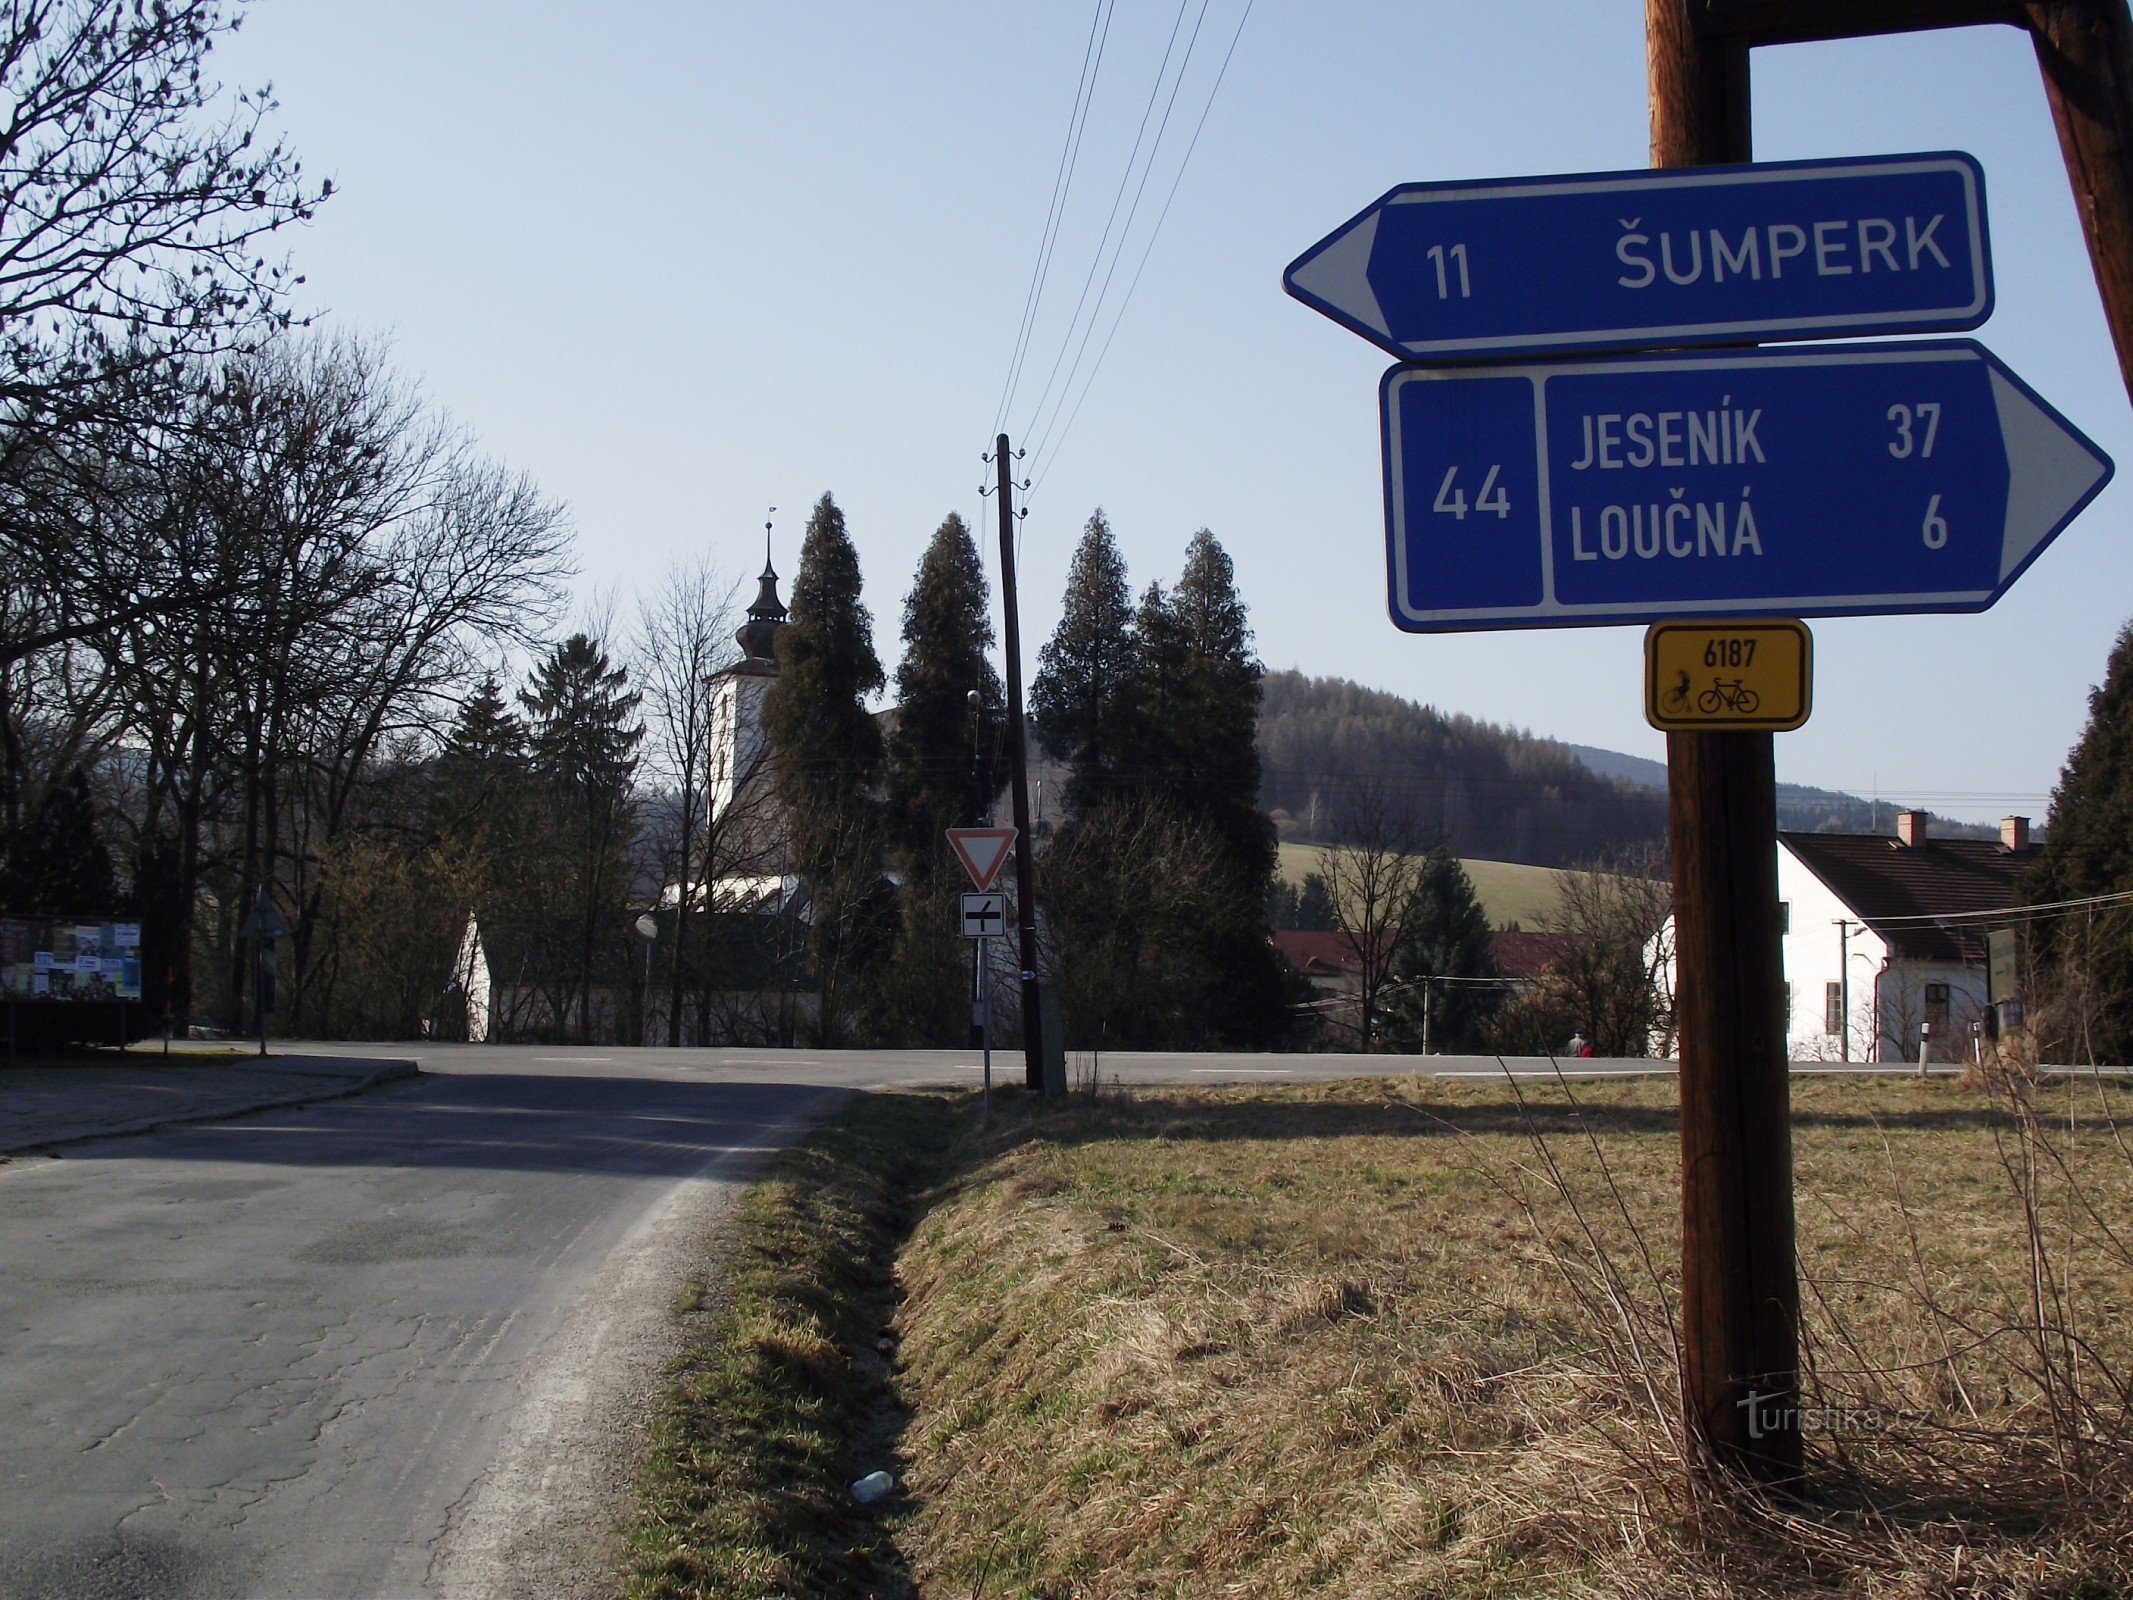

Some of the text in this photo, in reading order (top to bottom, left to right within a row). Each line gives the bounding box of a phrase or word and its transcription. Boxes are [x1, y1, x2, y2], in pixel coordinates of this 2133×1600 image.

[1427, 215, 1951, 300] 11 ŠUMPERK
[1571, 395, 1942, 470] JESENÍK 37
[1433, 465, 1512, 520] 44
[1572, 486, 1949, 561] LOUČNÁ 6
[1704, 639, 1757, 668] 6187
